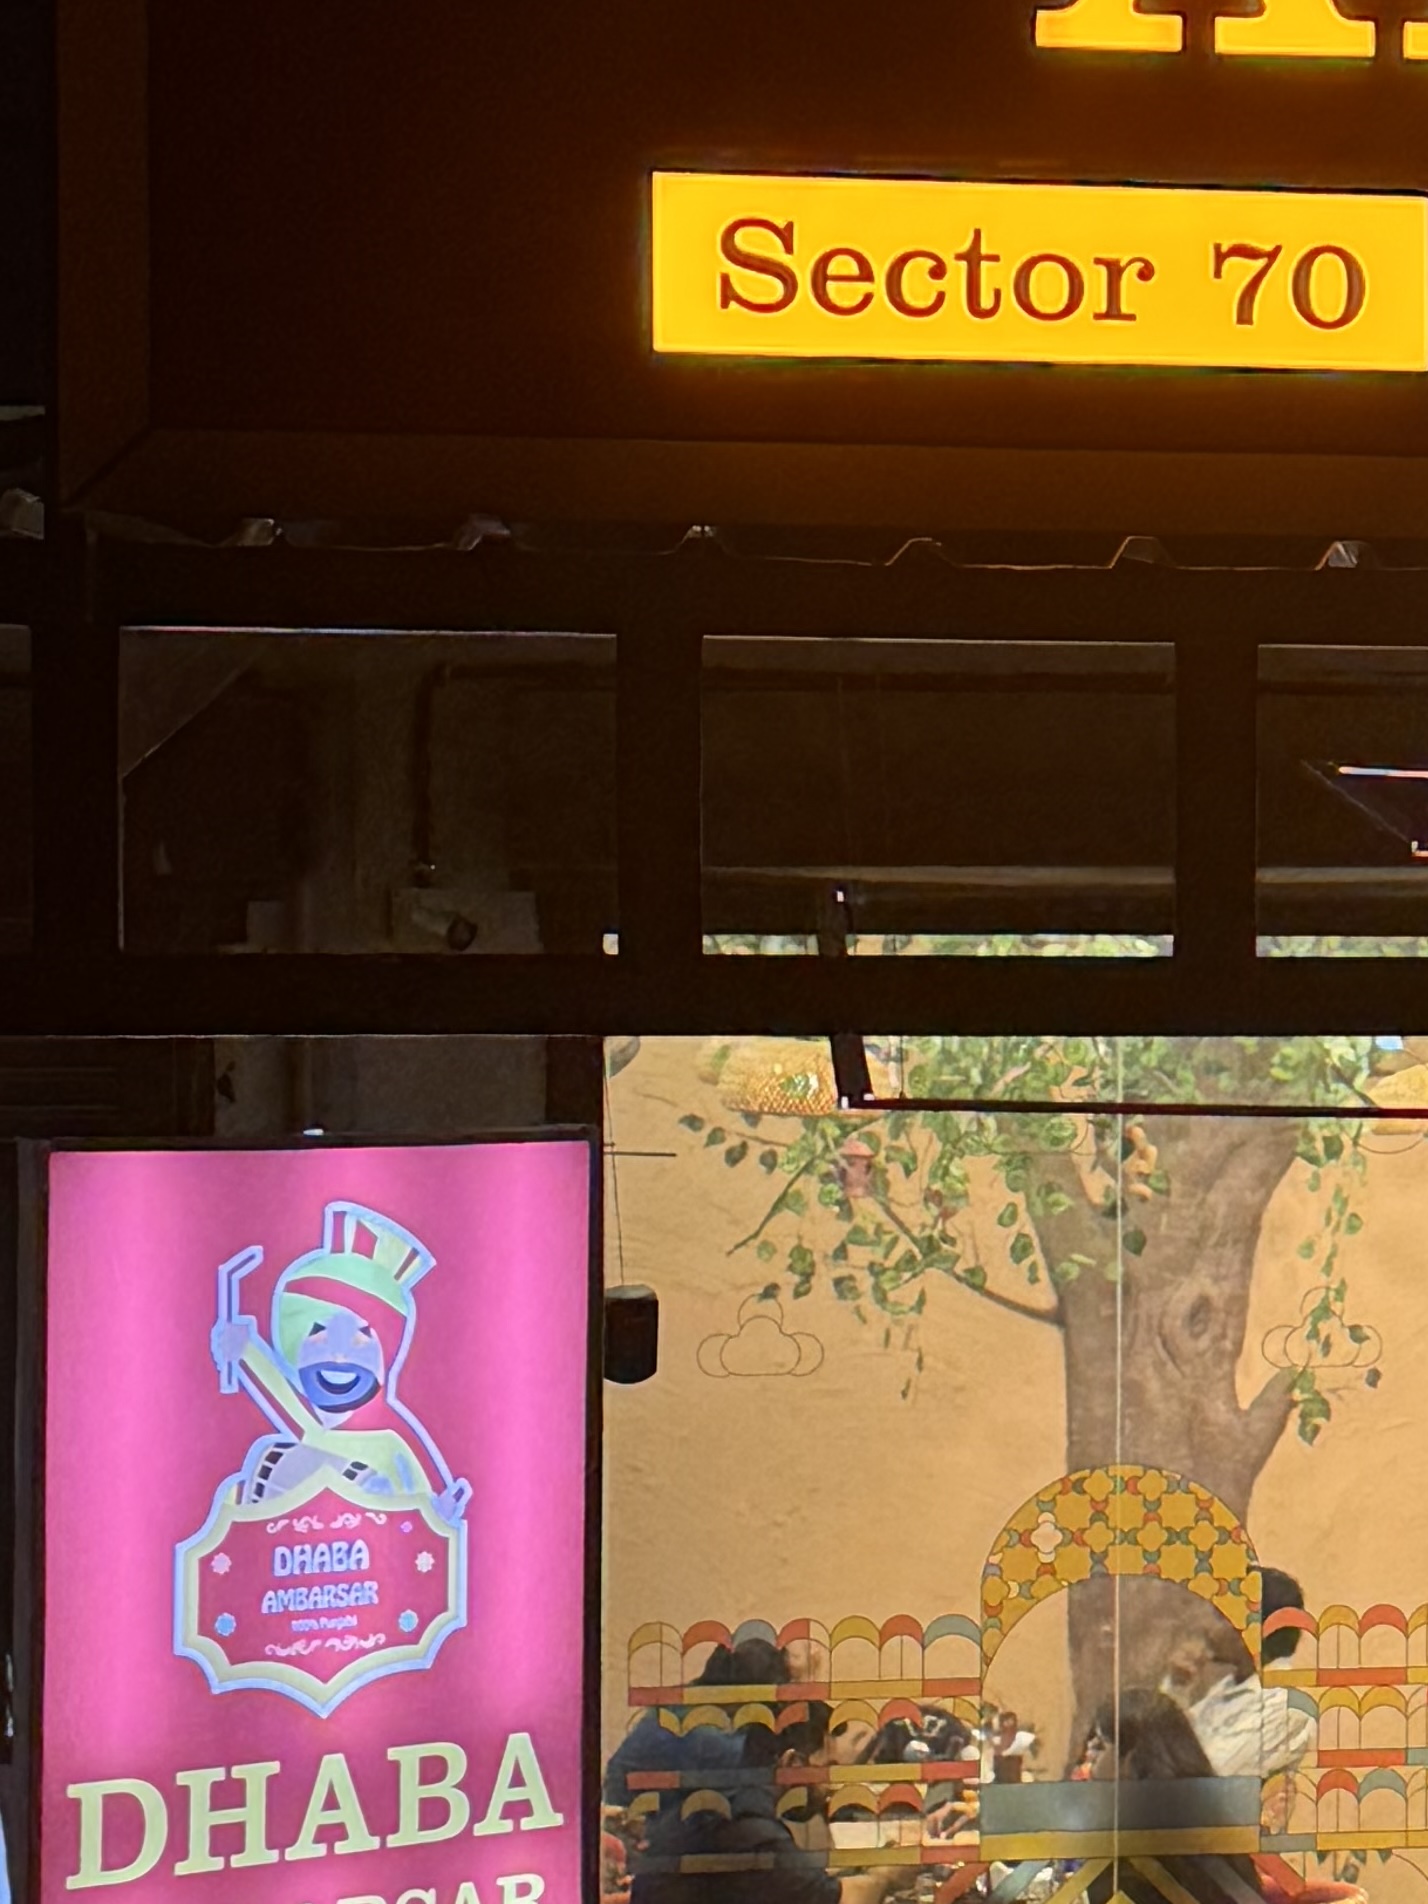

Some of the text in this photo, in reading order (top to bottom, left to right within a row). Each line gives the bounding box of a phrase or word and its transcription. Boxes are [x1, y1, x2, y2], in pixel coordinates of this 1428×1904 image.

[717, 215, 1368, 332] Sector 70
[273, 1538, 370, 1577] DHABA
[261, 1580, 379, 1614] AMBARSAR
[65, 1731, 565, 1891] DHABA
